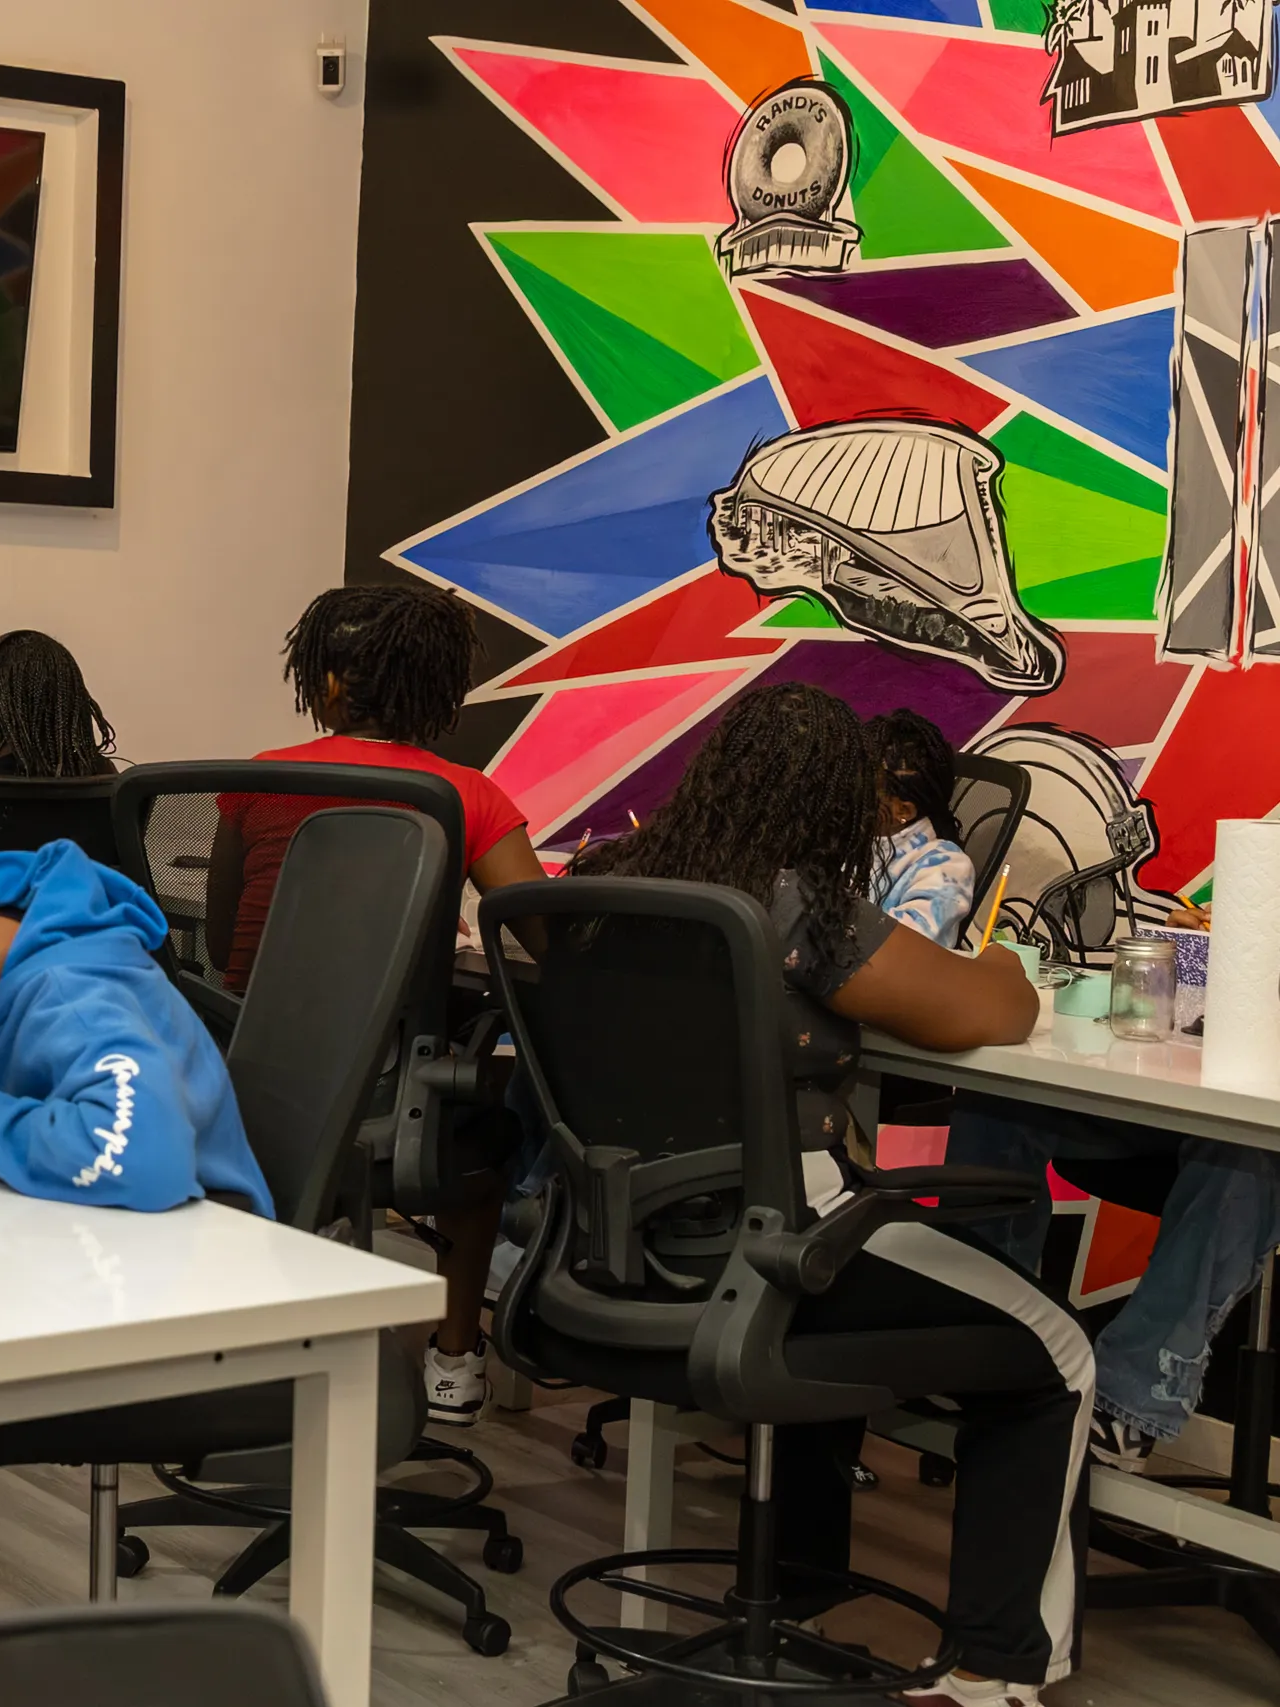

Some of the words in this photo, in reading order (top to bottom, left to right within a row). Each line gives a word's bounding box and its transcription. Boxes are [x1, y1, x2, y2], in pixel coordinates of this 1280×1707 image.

[755, 96, 828, 132] RANDY'S
[751, 180, 822, 208] DONUTS
[436, 1391, 454, 1399] AIR
